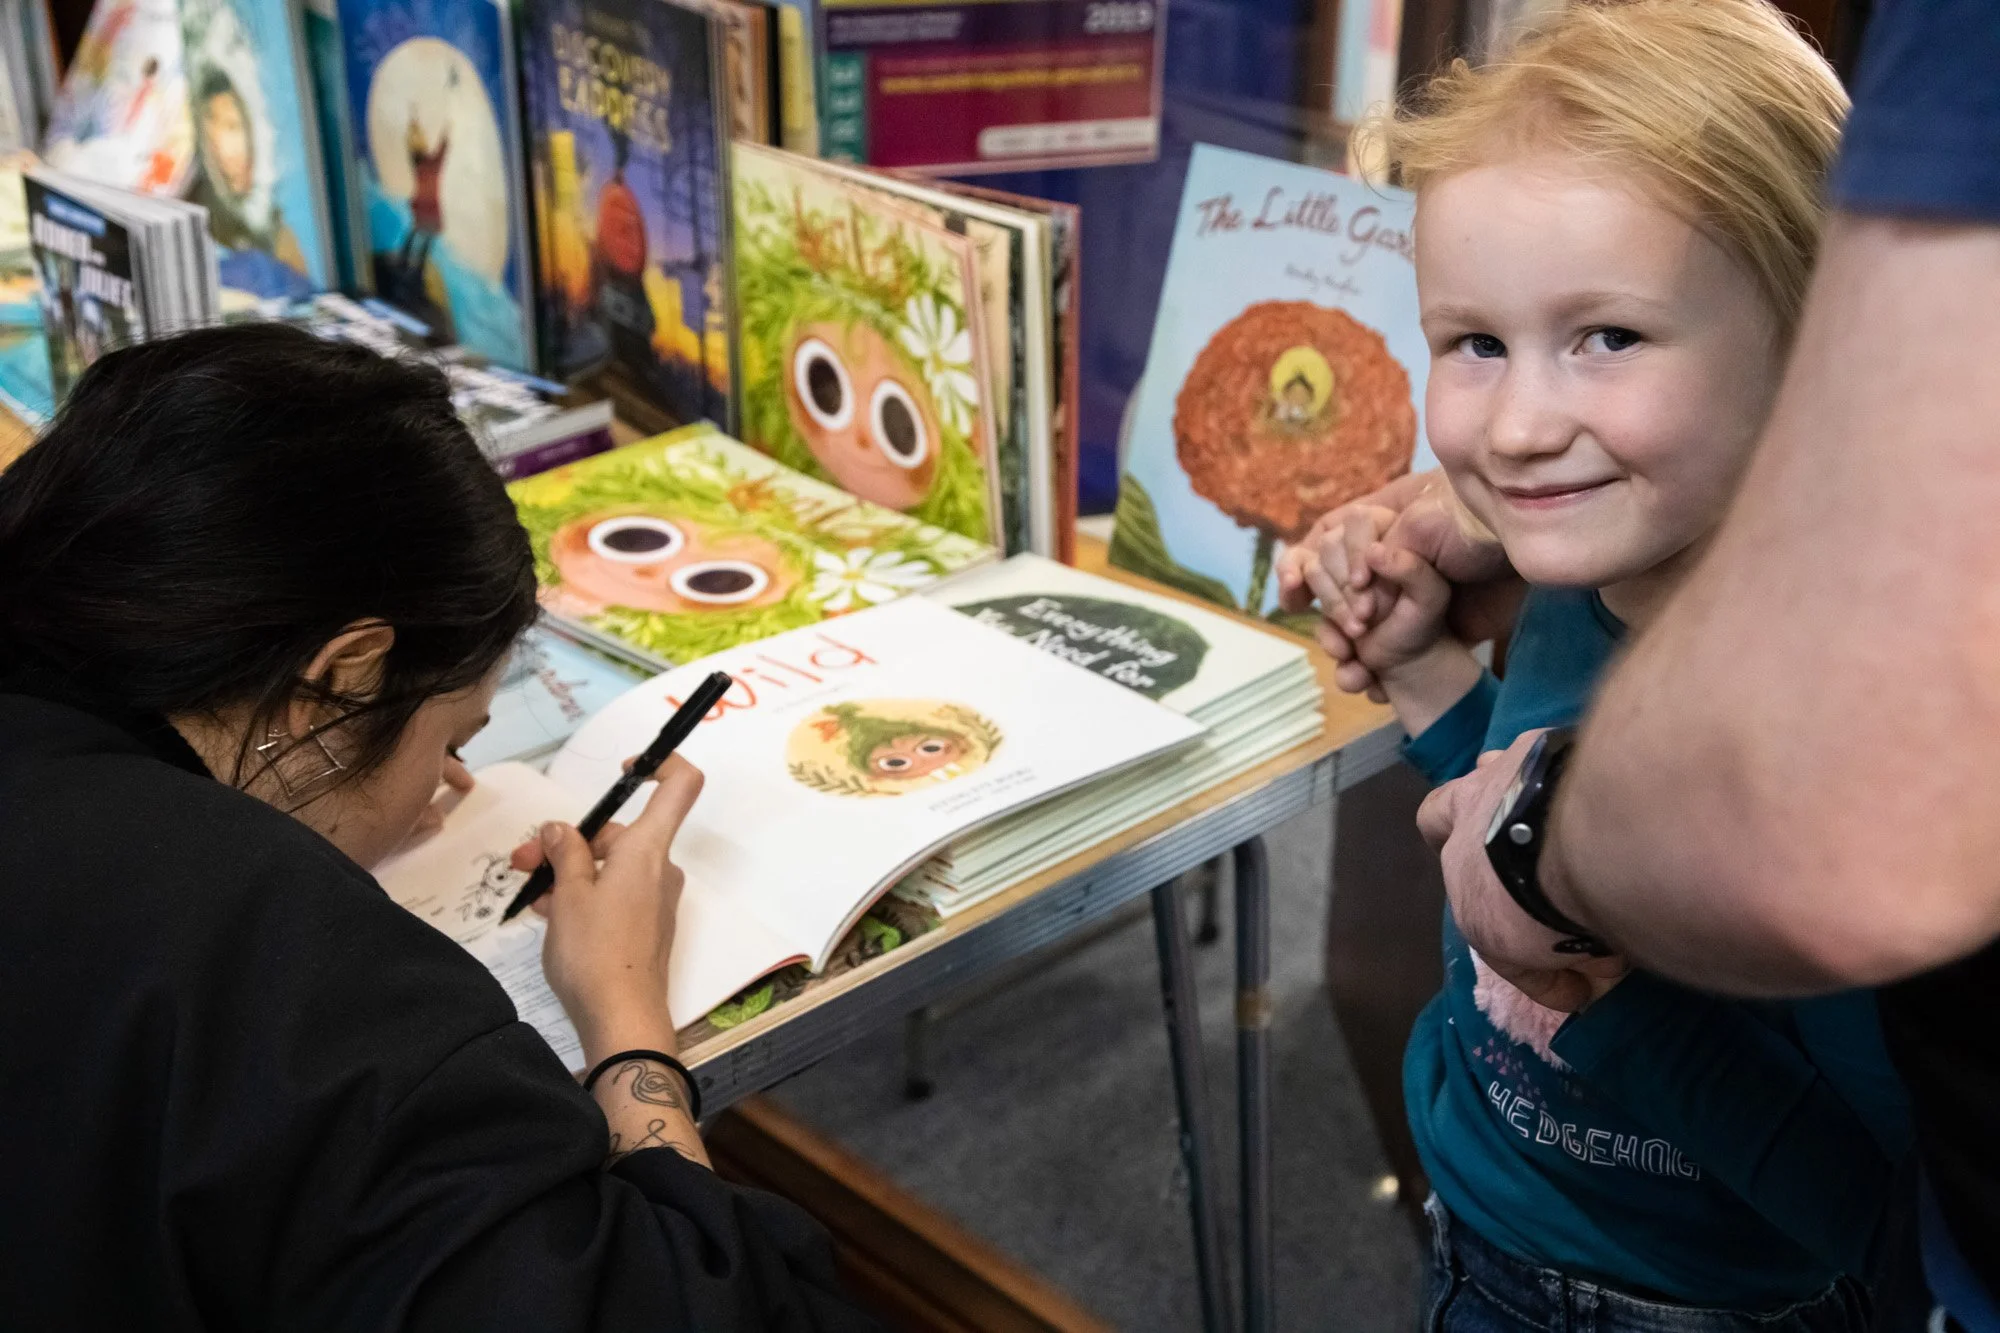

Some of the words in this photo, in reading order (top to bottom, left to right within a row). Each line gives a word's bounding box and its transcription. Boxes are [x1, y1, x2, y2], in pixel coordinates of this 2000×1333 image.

[1195, 192, 1243, 240] The
[1251, 184, 1341, 235] Little
[1338, 205, 1416, 268] Gar
[1016, 597, 1179, 668] Everything
[1102, 659, 1156, 689] for
[1488, 1080, 1700, 1181] HEDGEHOG
